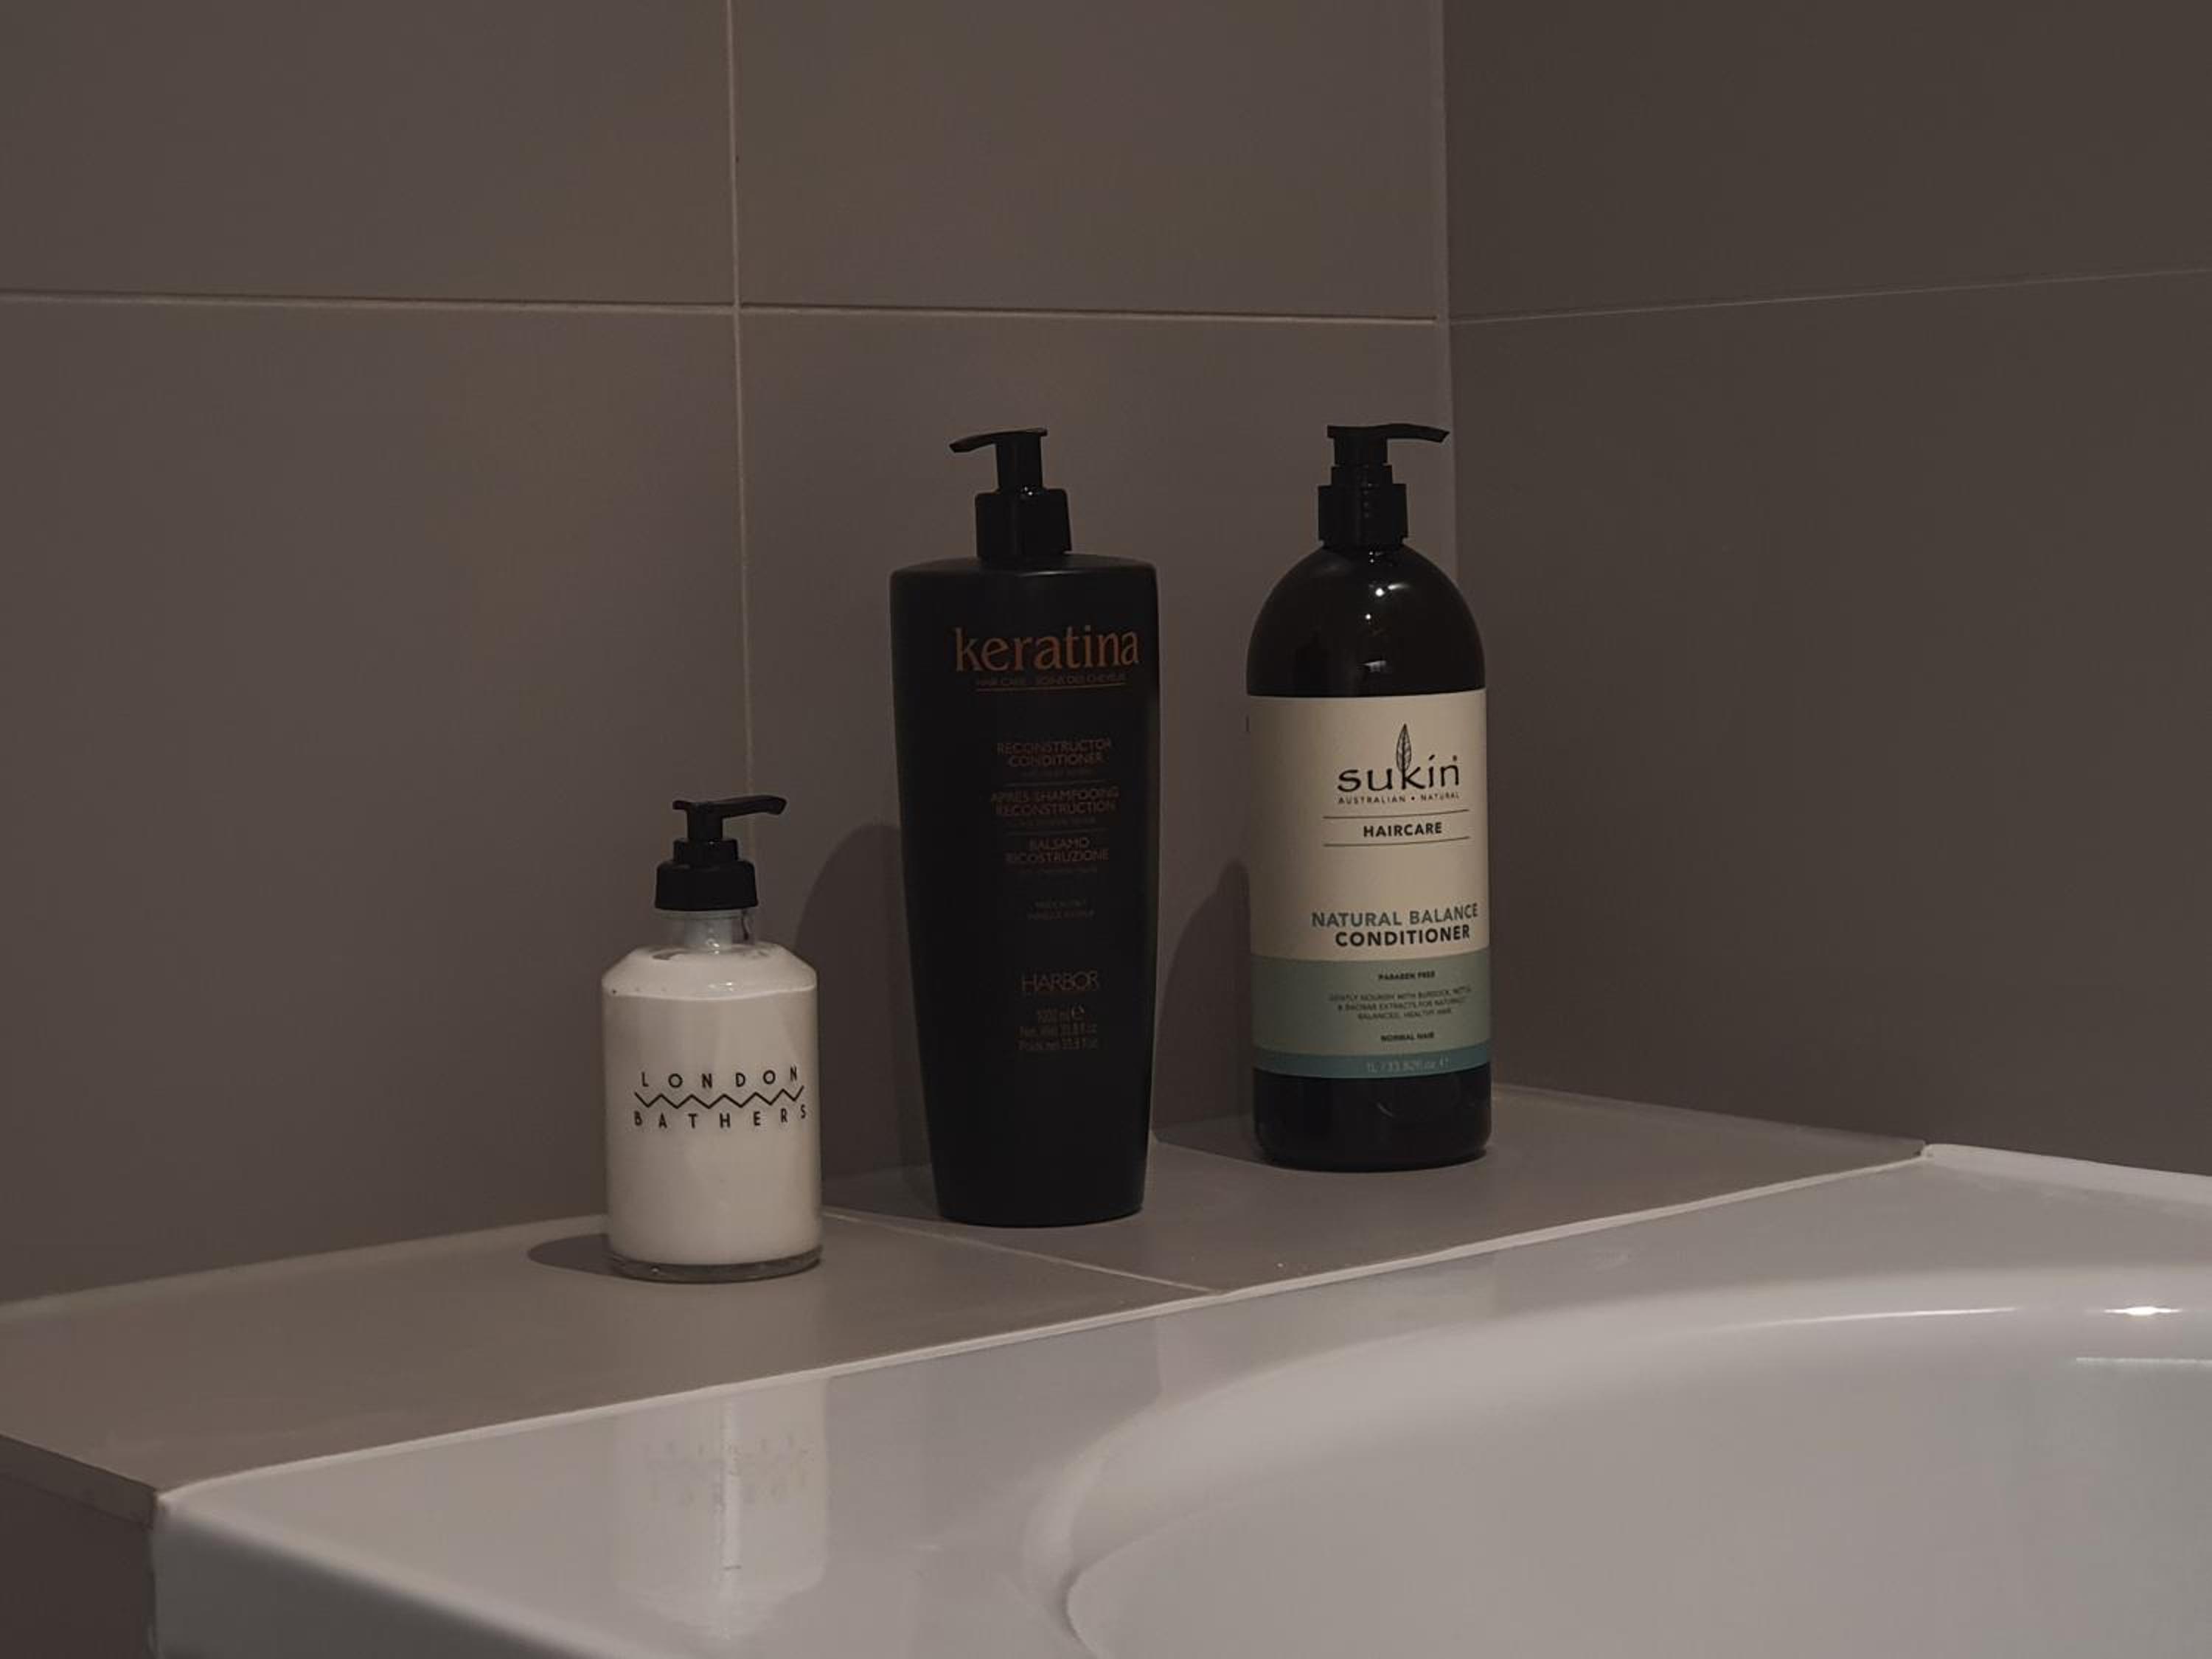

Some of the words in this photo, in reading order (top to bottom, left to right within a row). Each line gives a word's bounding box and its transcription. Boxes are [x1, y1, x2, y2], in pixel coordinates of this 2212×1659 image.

[954, 624, 1141, 672] keratina
[1338, 795, 1406, 805] AUSTRALIAN
[1421, 792, 1460, 801] NATURAL
[1363, 822, 1443, 838] HAIRCARE
[1312, 910, 1402, 928] NATURAL
[1409, 902, 1479, 925] BALANCE
[1335, 924, 1470, 947] CONDITIONER
[1021, 970, 1099, 992] HARBOR
[641, 1066, 797, 1088] LONDON
[634, 1104, 806, 1129] BATHERS
